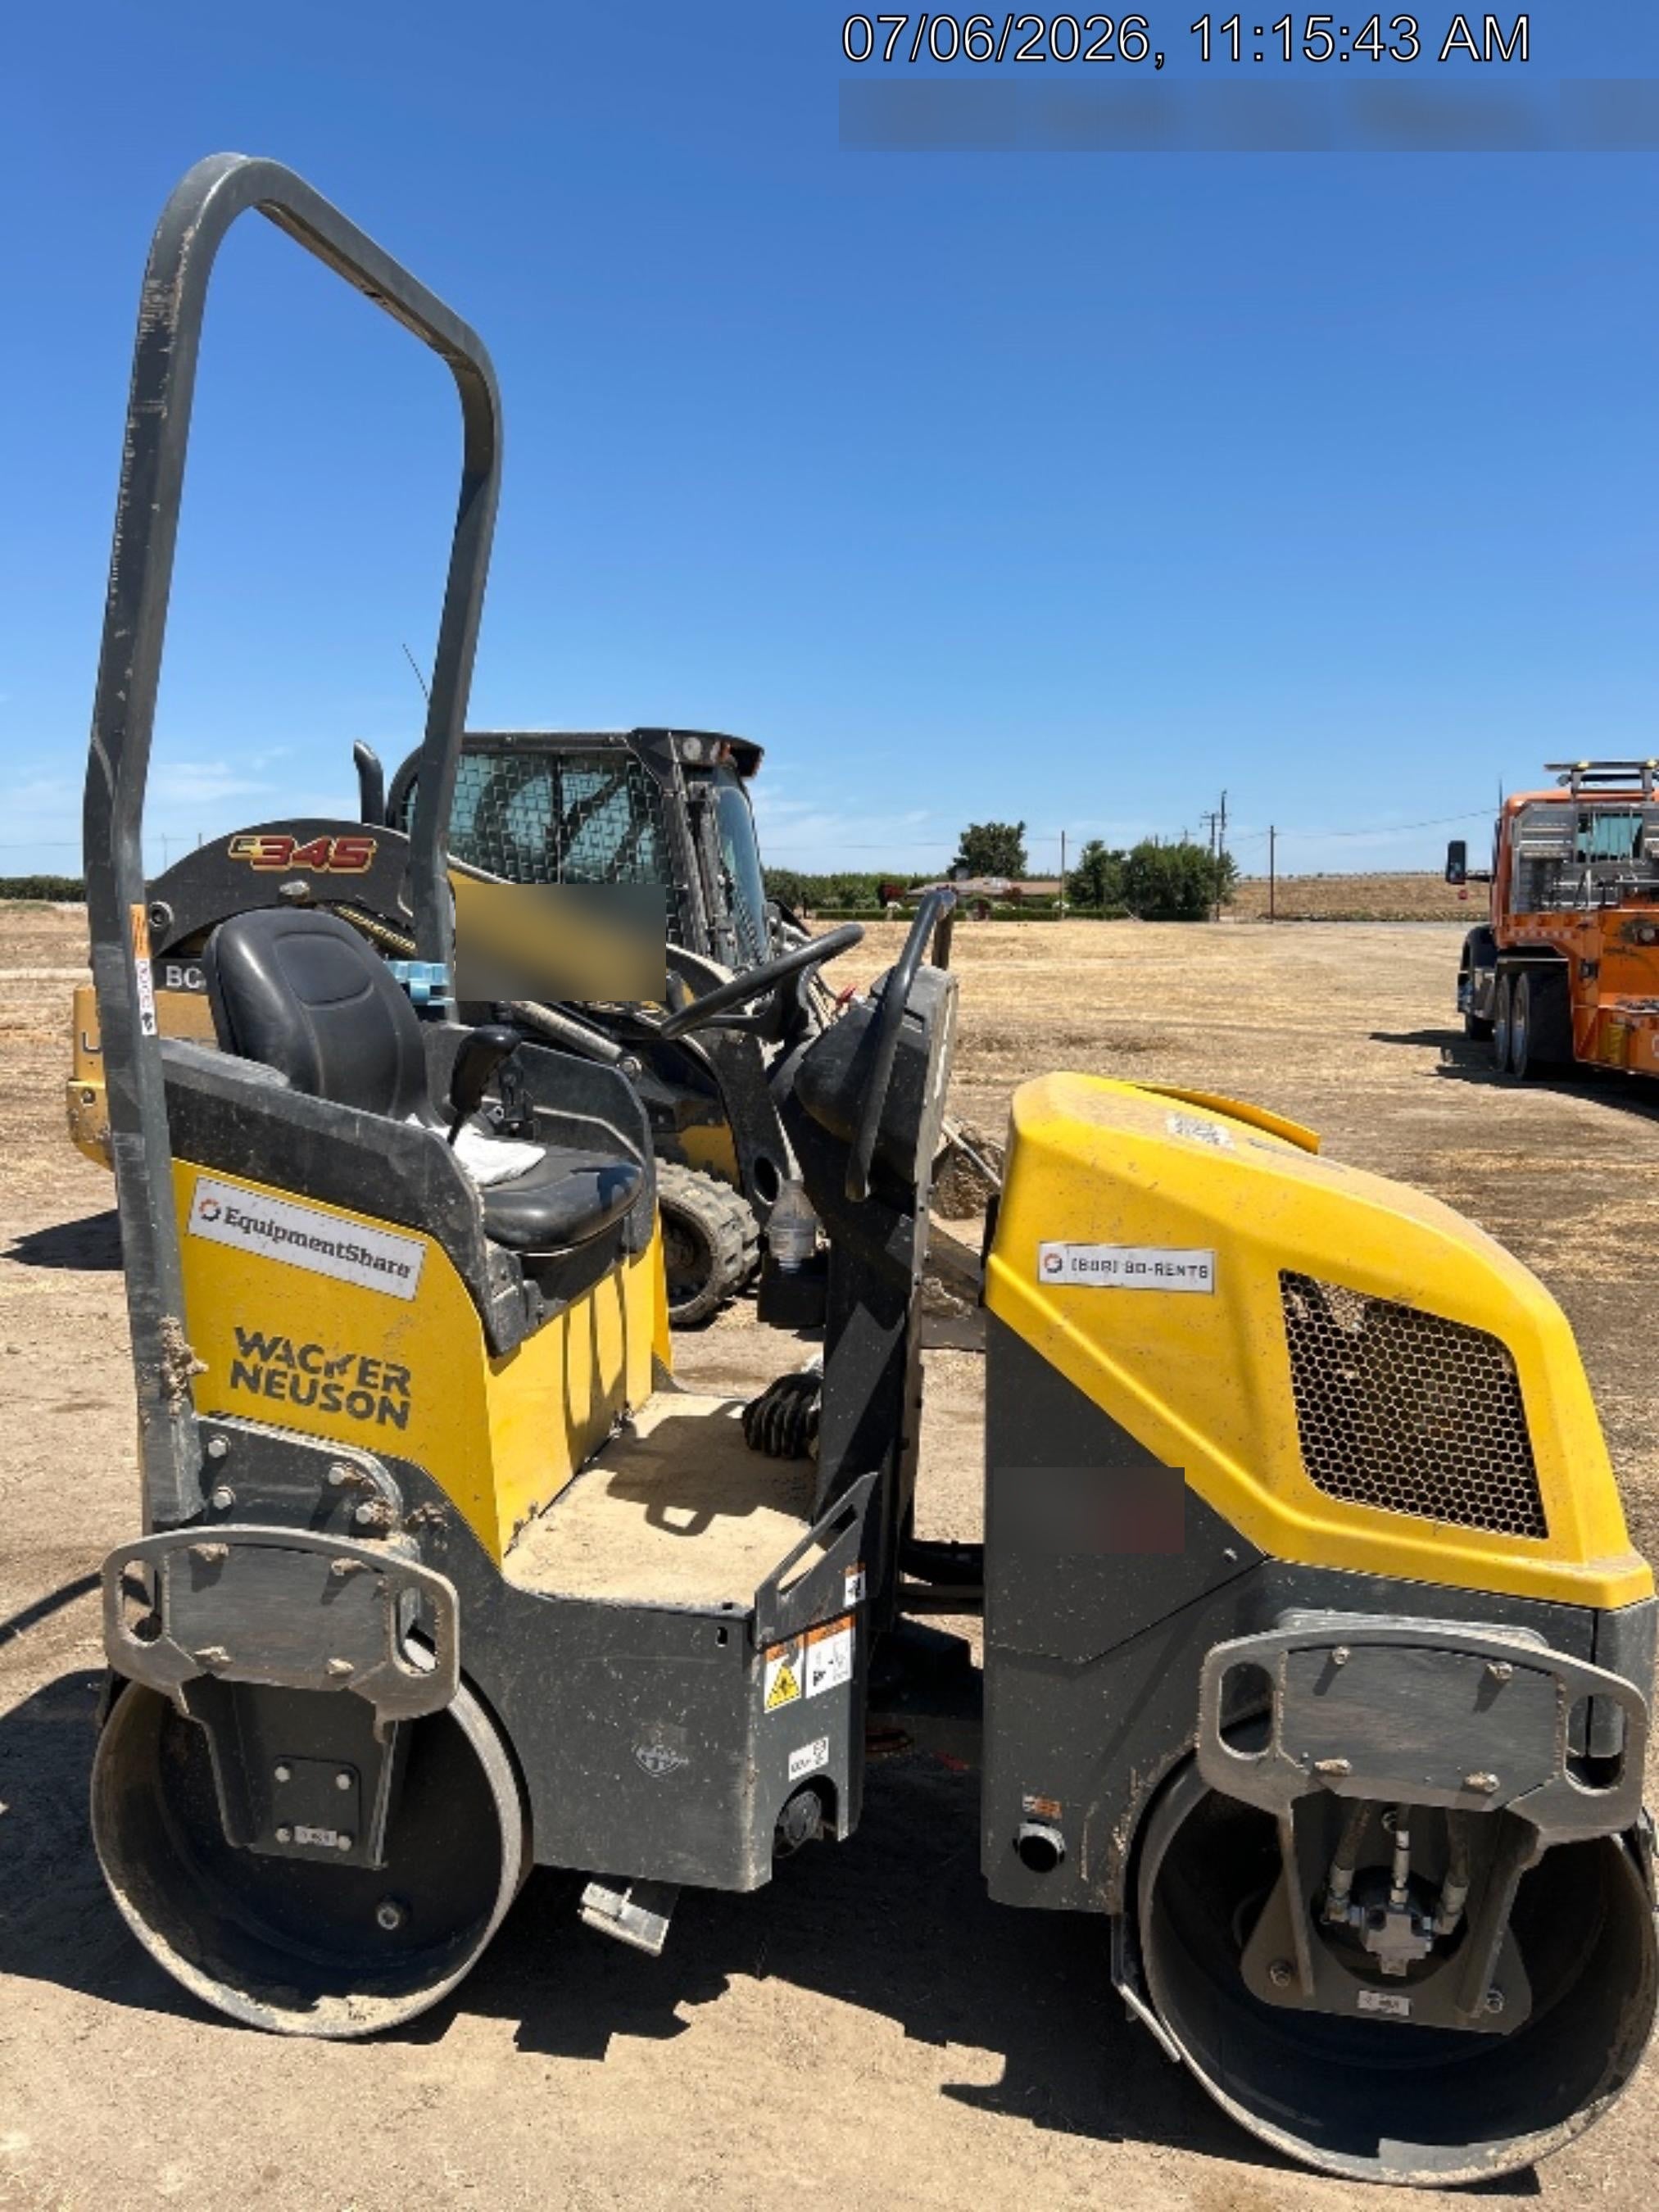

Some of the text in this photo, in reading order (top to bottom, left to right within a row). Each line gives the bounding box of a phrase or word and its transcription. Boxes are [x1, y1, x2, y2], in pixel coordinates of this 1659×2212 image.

[224, 1207, 410, 1278] EquipmentShare
[230, 1358, 410, 1430] NEUSON
[233, 1326, 410, 1397] WACKER
